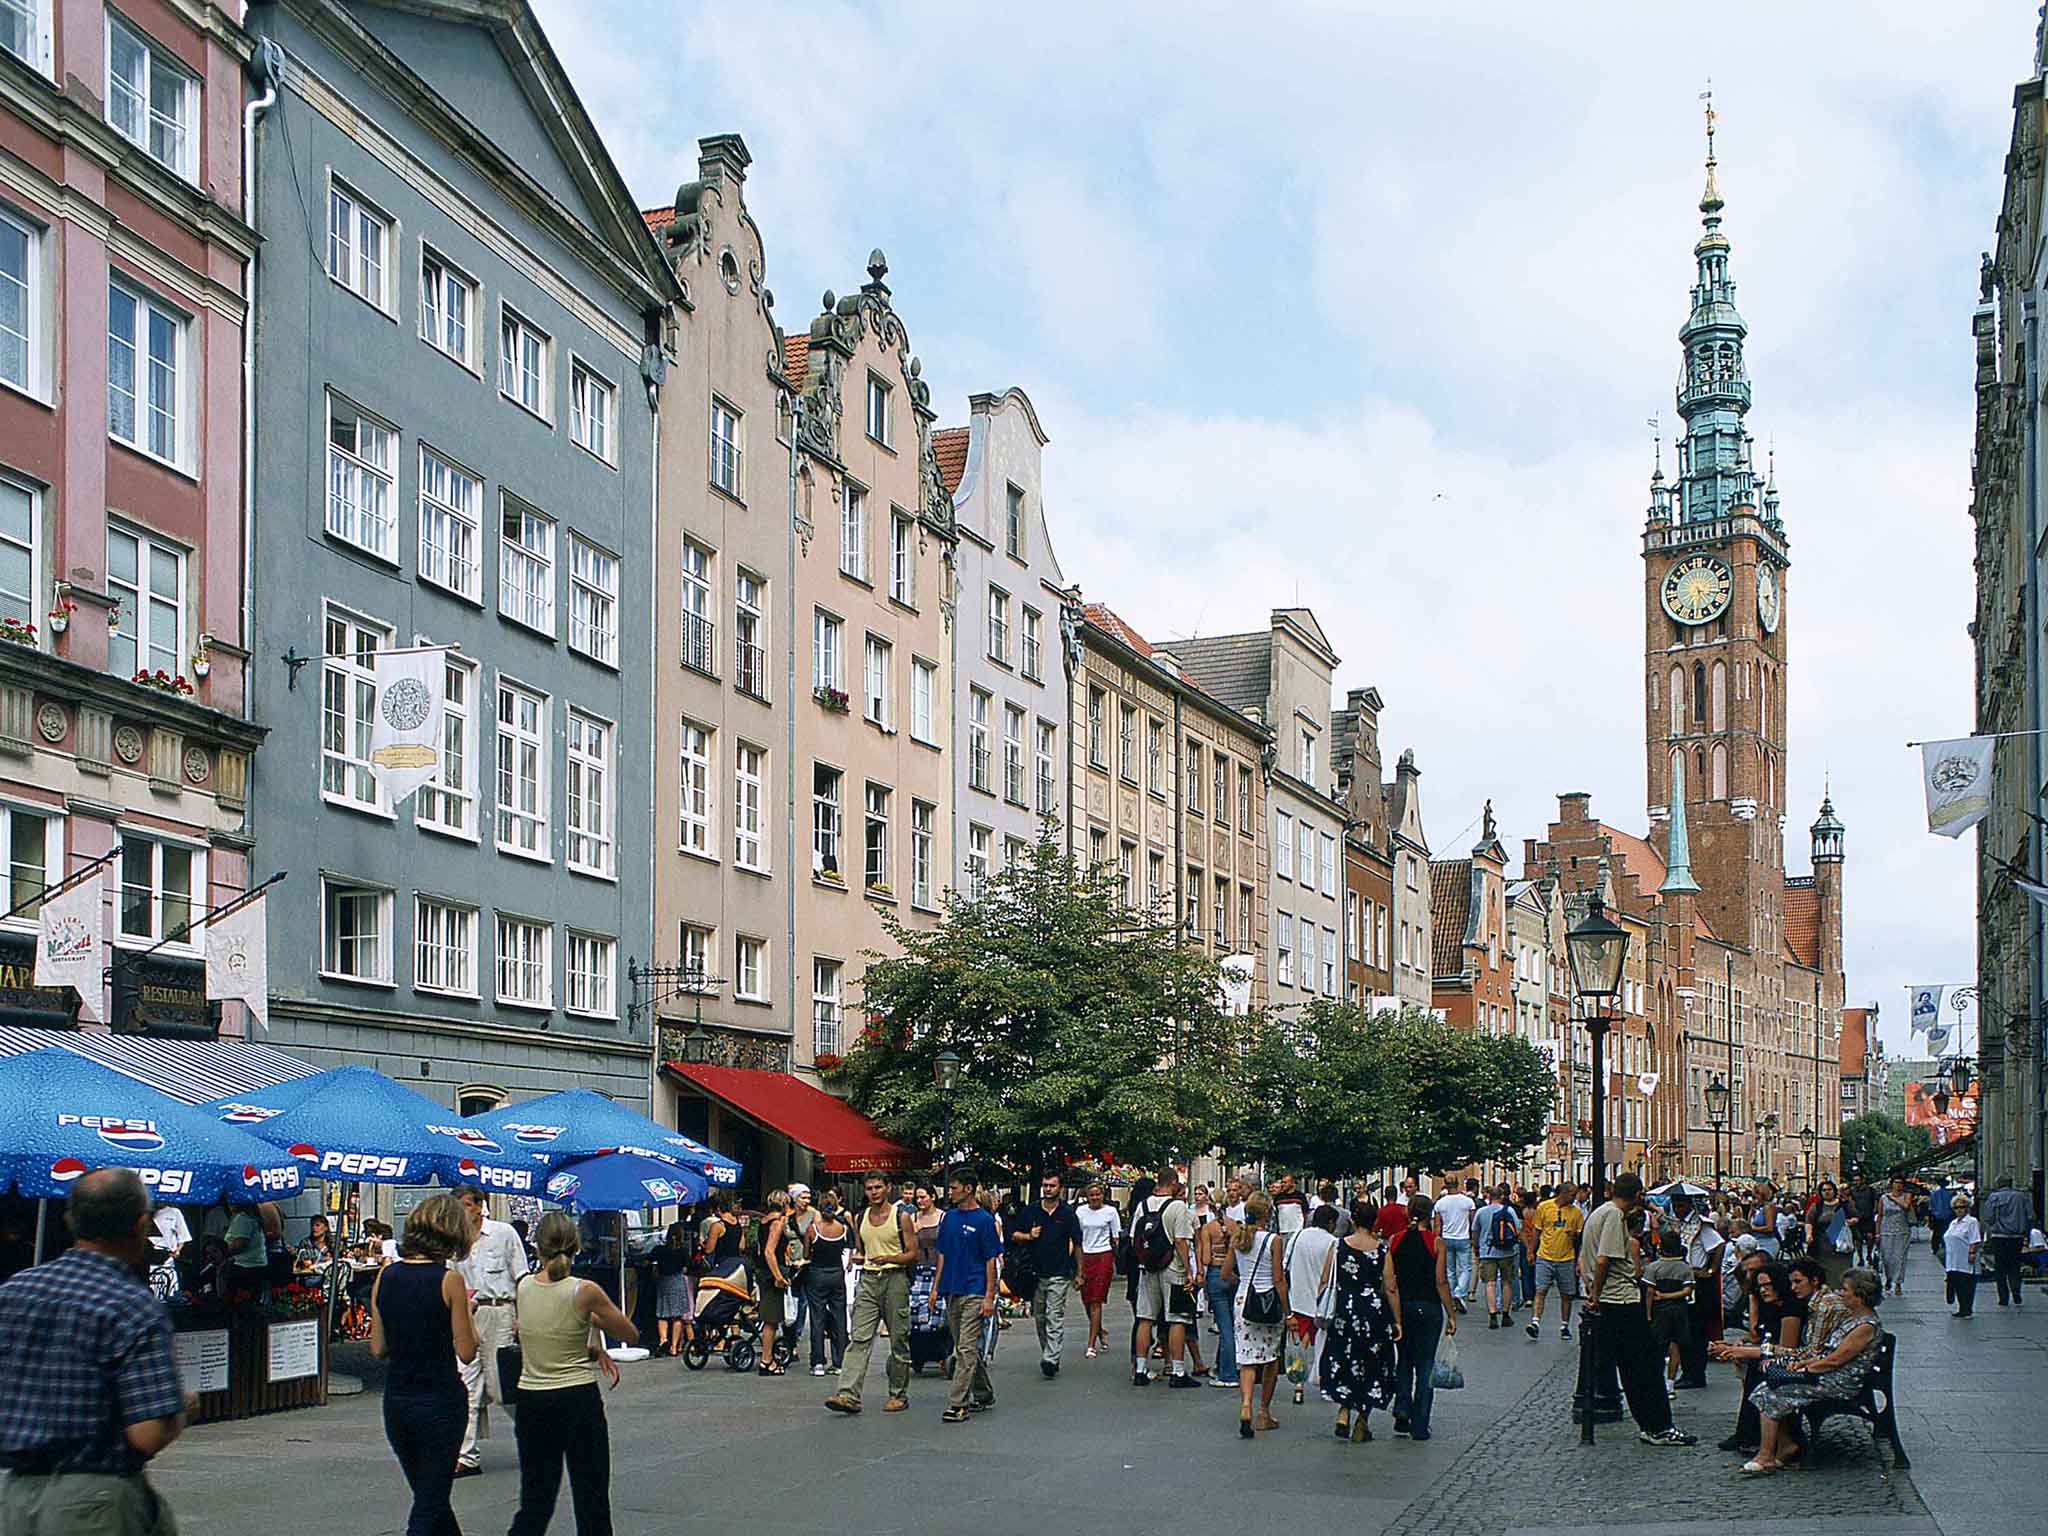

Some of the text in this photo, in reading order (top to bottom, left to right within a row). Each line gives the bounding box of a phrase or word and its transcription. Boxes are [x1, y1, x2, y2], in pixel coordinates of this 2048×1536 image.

[144, 984, 209, 1008] RESTAURAN
[57, 1114, 156, 1132] PEPSI
[425, 1124, 486, 1139] PEPSI
[502, 1123, 567, 1134] PEPSI
[320, 1151, 408, 1177] PEPSI
[261, 1166, 299, 1191] PEPSI
[480, 1165, 531, 1190] PEPSI
[713, 1166, 736, 1184] PEPSI
